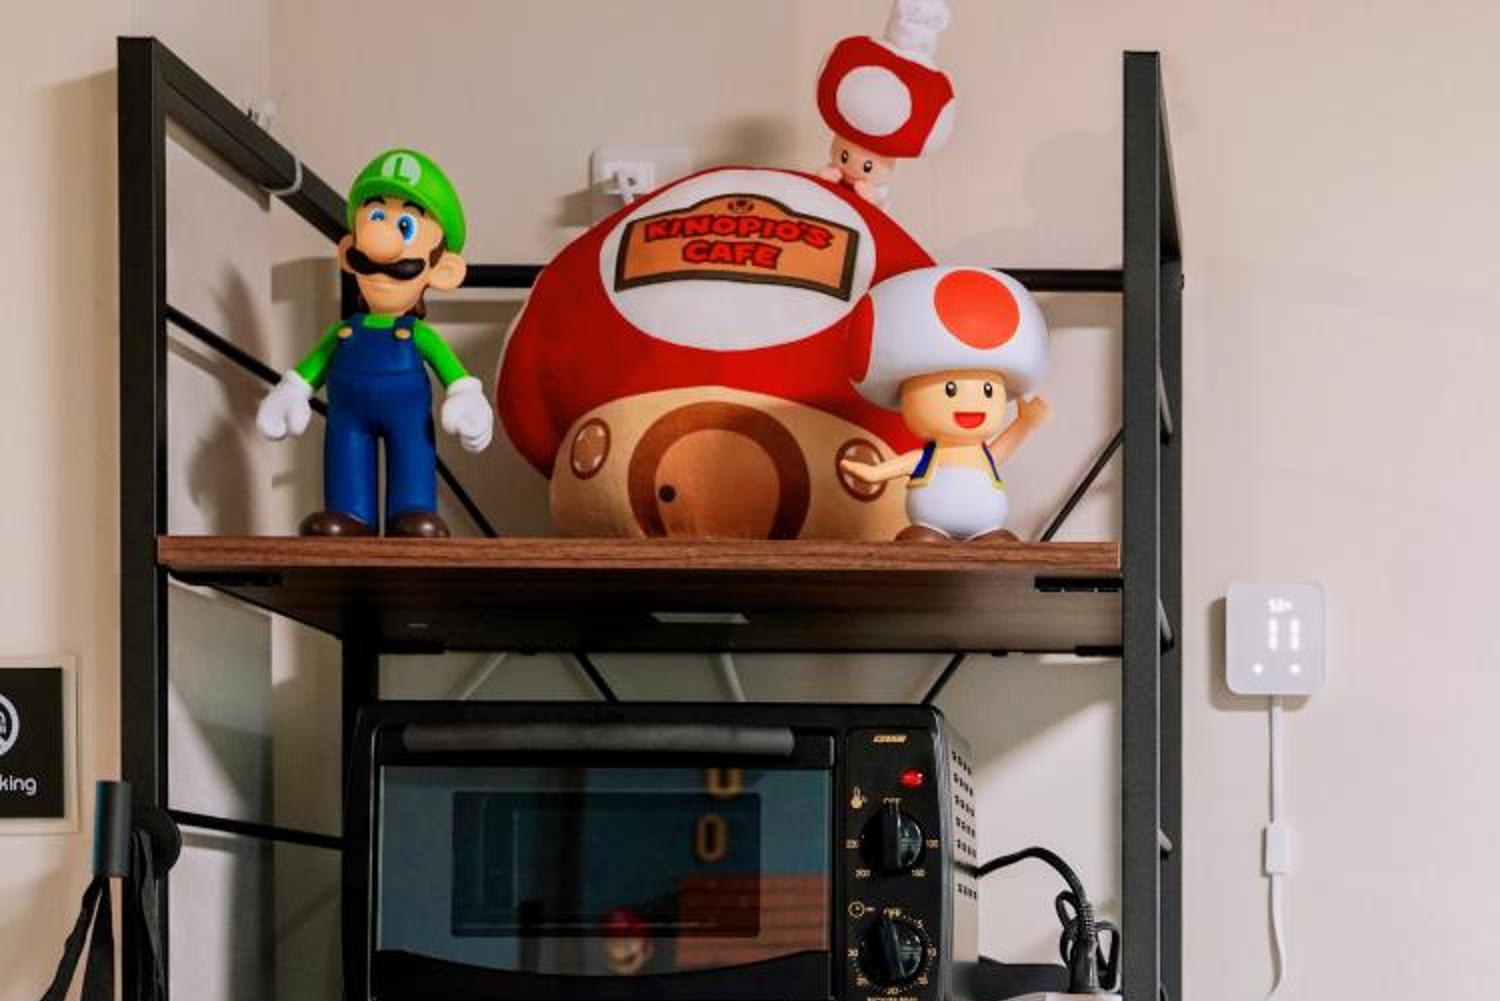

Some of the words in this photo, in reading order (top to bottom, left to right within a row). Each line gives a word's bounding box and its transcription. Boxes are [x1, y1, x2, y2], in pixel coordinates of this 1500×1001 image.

[394, 157, 411, 181] L
[644, 213, 834, 250] KINOPIO'S
[682, 239, 783, 270] CAFE
[0, 775, 37, 796] king
